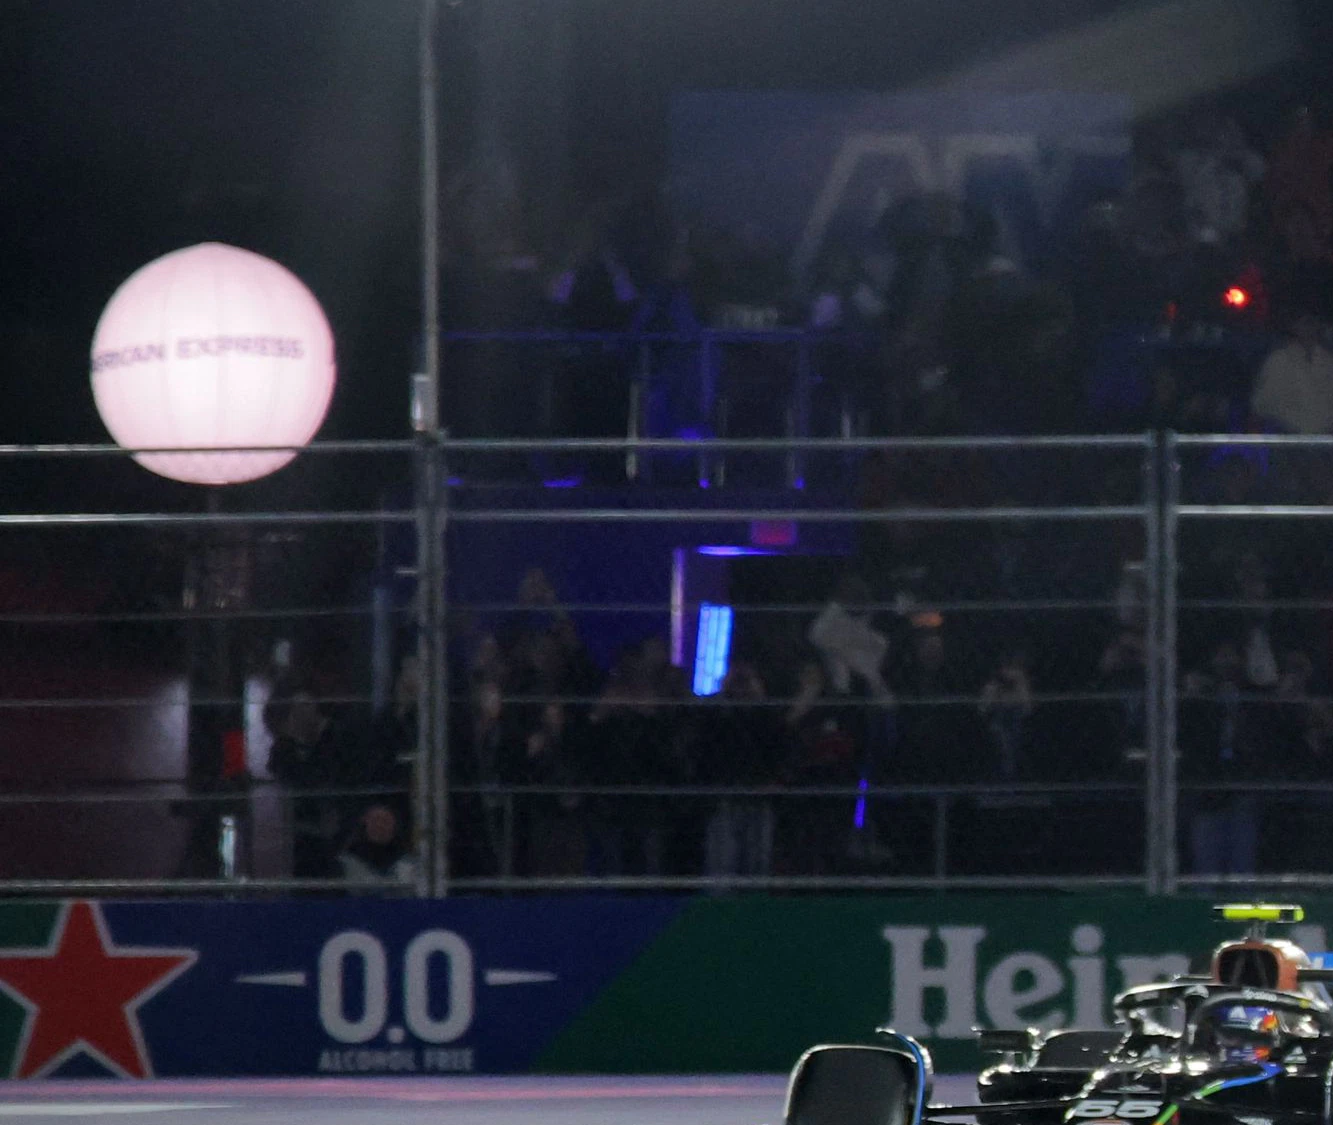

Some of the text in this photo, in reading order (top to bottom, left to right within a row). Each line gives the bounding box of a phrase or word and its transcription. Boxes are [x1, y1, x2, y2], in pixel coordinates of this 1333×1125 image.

[319, 929, 474, 1044] 0.0
[884, 924, 1190, 1040] Hein
[424, 1049, 474, 1071] FREE
[1073, 1100, 1163, 1118] 55
